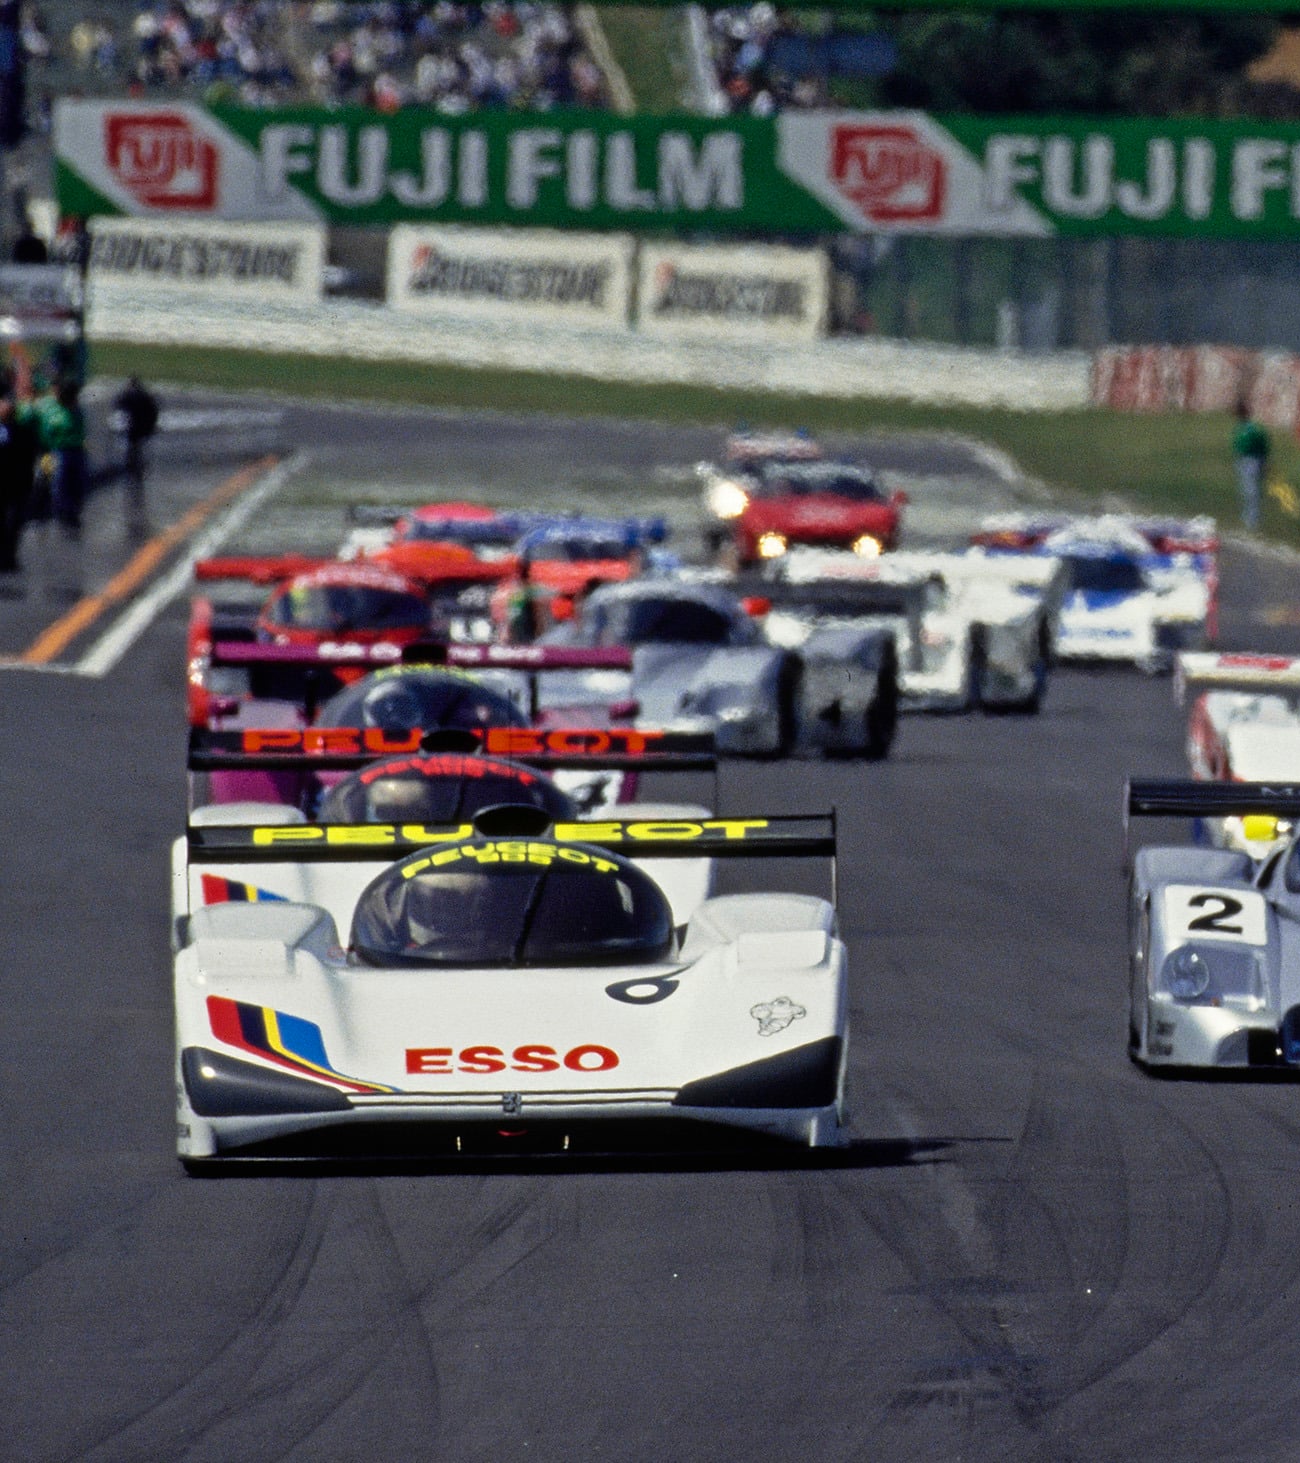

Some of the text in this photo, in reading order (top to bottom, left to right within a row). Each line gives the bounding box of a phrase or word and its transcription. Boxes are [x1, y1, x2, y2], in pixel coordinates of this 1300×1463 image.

[260, 122, 743, 210] FUJI FILM
[984, 133, 1214, 220] FUJI
[242, 727, 665, 755] PEUEOT
[253, 819, 769, 846] PEUEOT
[401, 842, 620, 879] PEUGEOT
[1188, 894, 1244, 934] 2
[405, 1044, 619, 1074] ESSO
